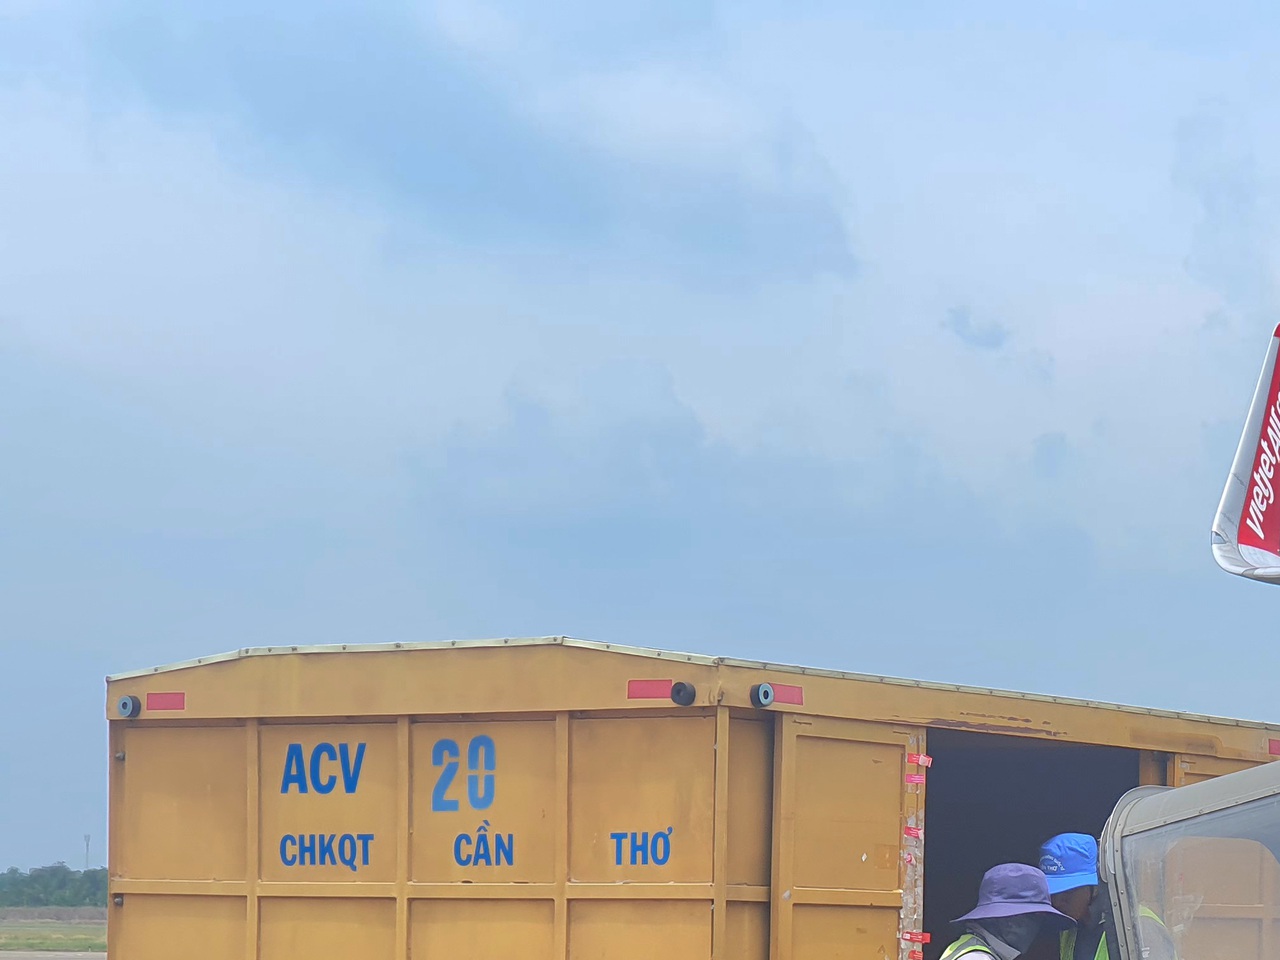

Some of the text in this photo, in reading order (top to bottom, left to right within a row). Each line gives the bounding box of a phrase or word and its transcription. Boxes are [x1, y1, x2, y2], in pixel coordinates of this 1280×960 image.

[281, 743, 366, 794] ACV
[432, 735, 495, 812] 20
[280, 821, 672, 871] CHKQT CẦN THƠ
